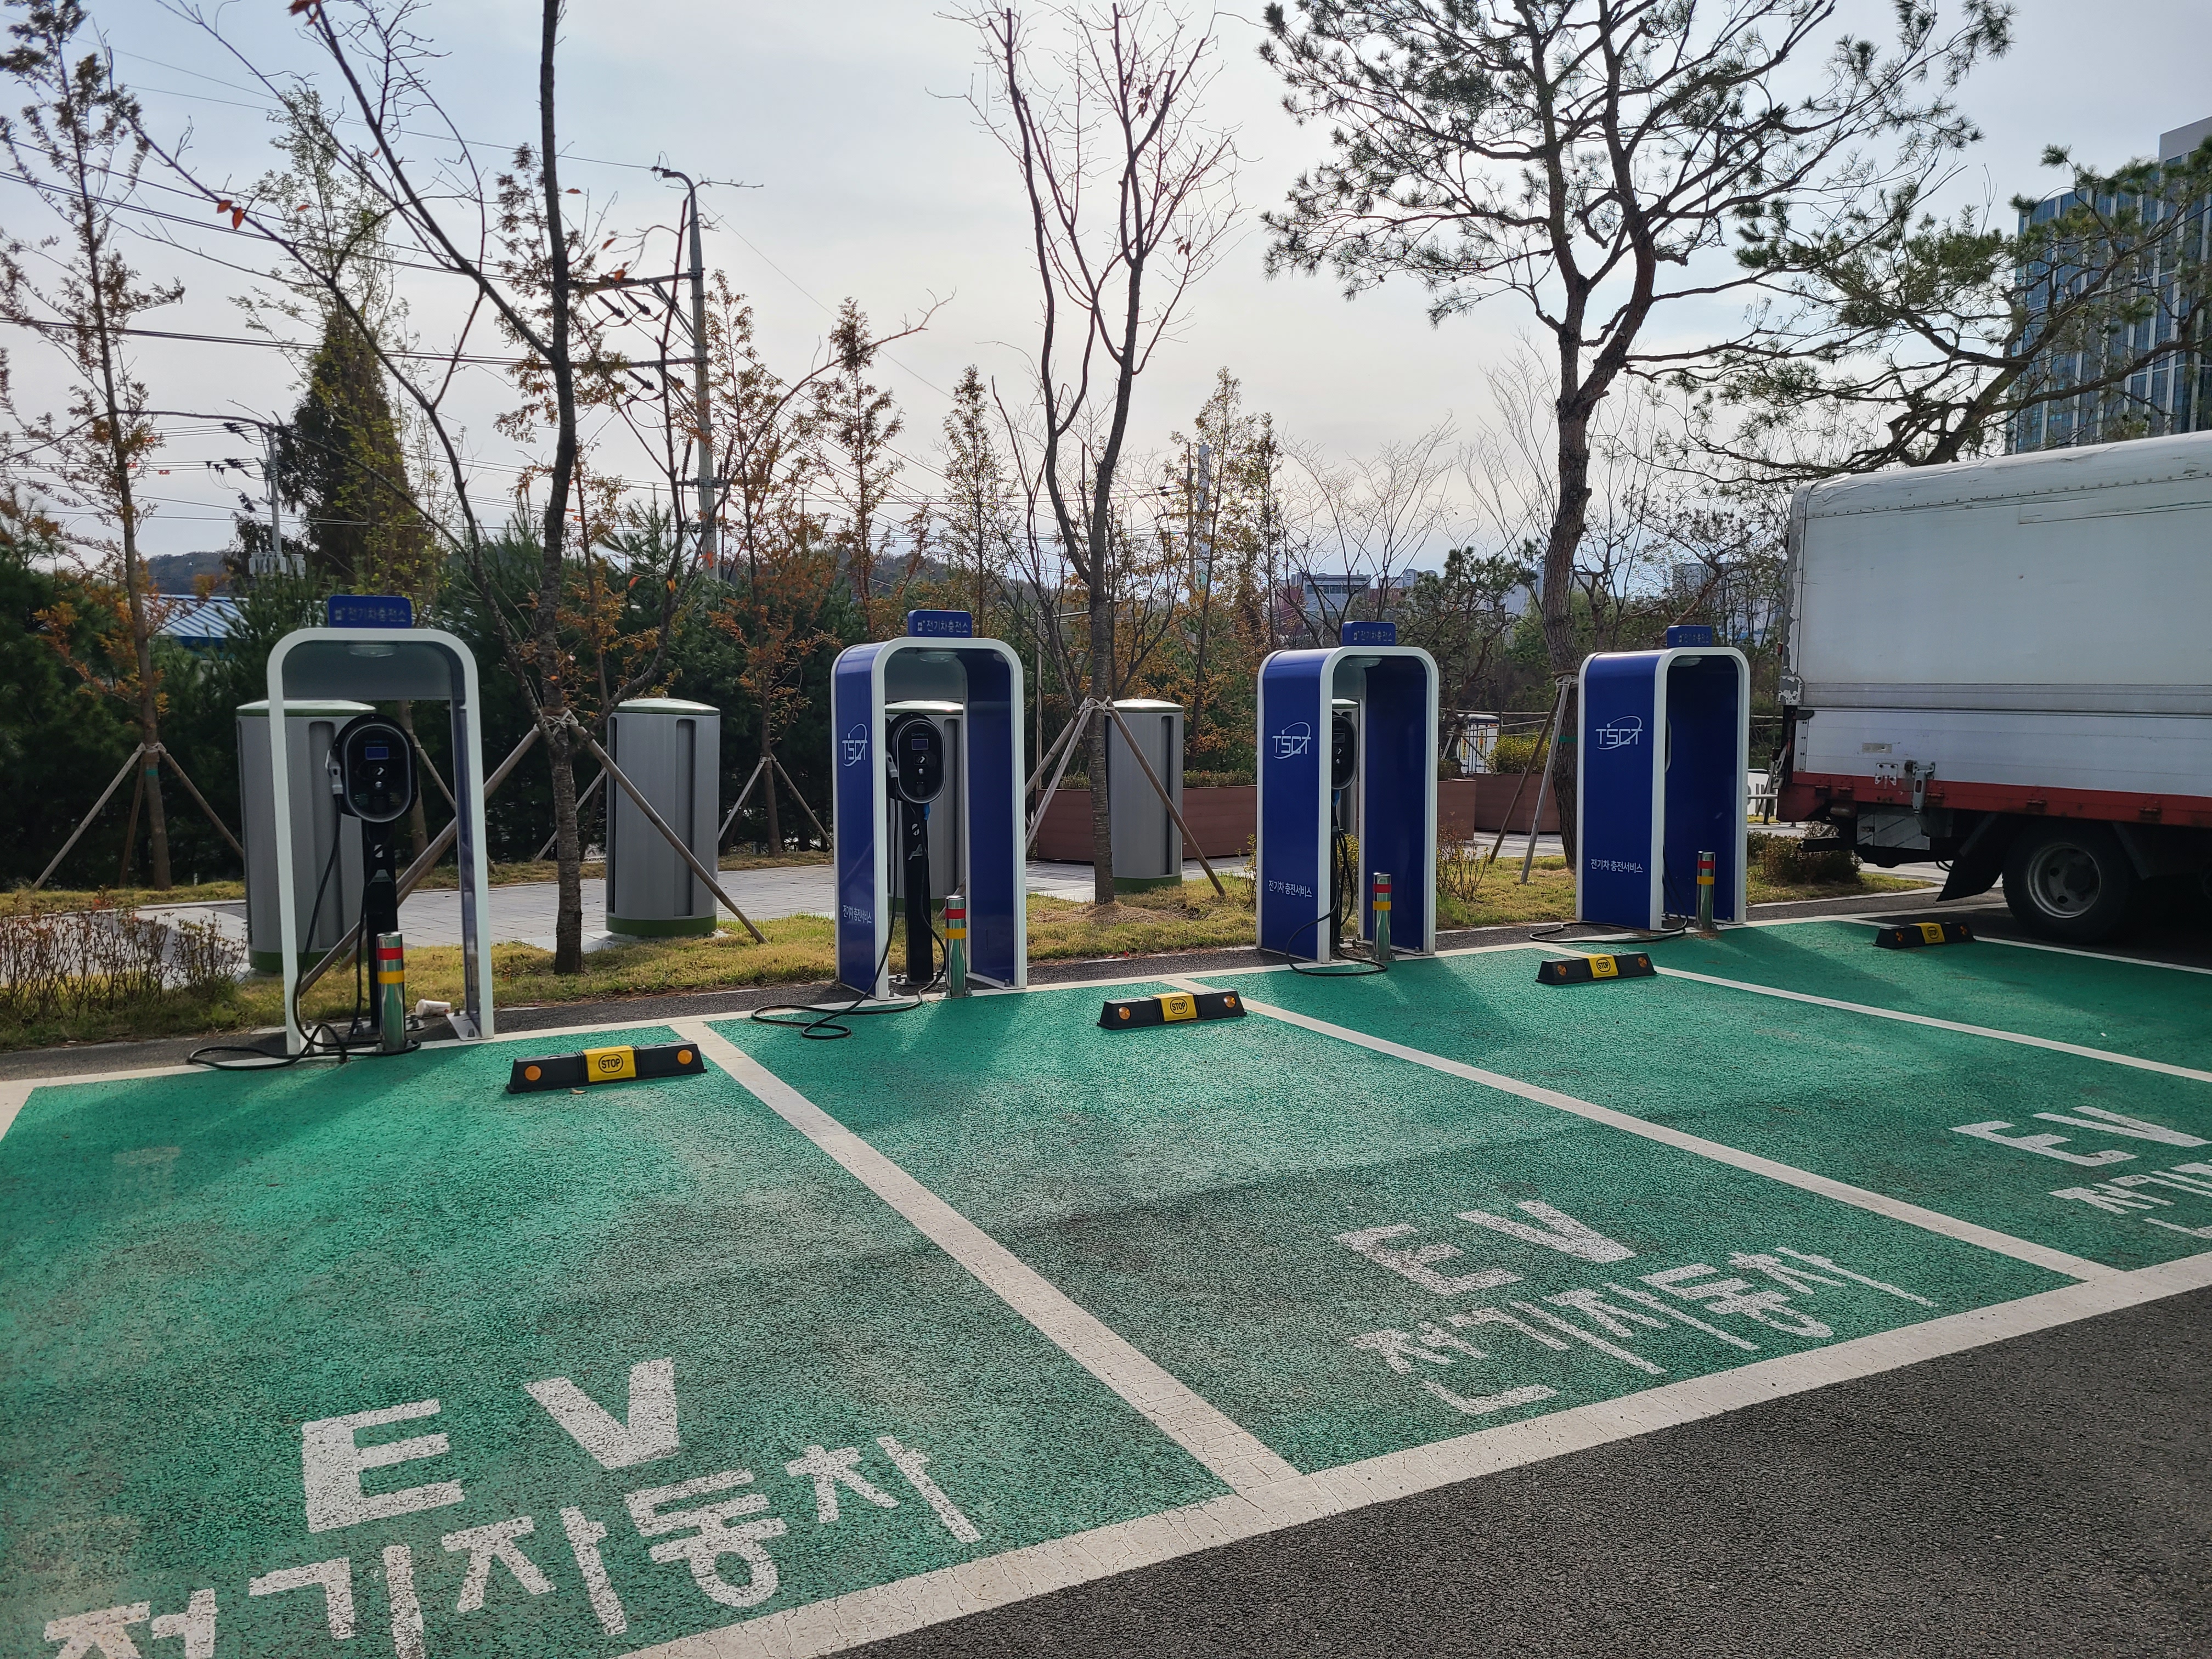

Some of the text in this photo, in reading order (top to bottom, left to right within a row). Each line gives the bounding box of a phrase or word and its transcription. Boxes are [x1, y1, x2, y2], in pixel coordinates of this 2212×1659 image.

[926, 620, 969, 633] 전기차충전소
[1361, 630, 1393, 641] 전기차충전소
[1272, 735, 1312, 755] TSCT
[1595, 729, 1643, 745] TSCT
[1590, 859, 1644, 873] 전기차 충전서비스
[1268, 880, 1312, 898] 전기차 충전서비스
[843, 905, 872, 924] 전기차 충전서비스
[1172, 1002, 1186, 1011] STOP
[601, 1059, 621, 1069] STOP
[1948, 1106, 2212, 1166] EV
[1333, 1200, 1638, 1296] EV
[1347, 1246, 1938, 1415] 전기자동차
[301, 1357, 680, 1533] EV
